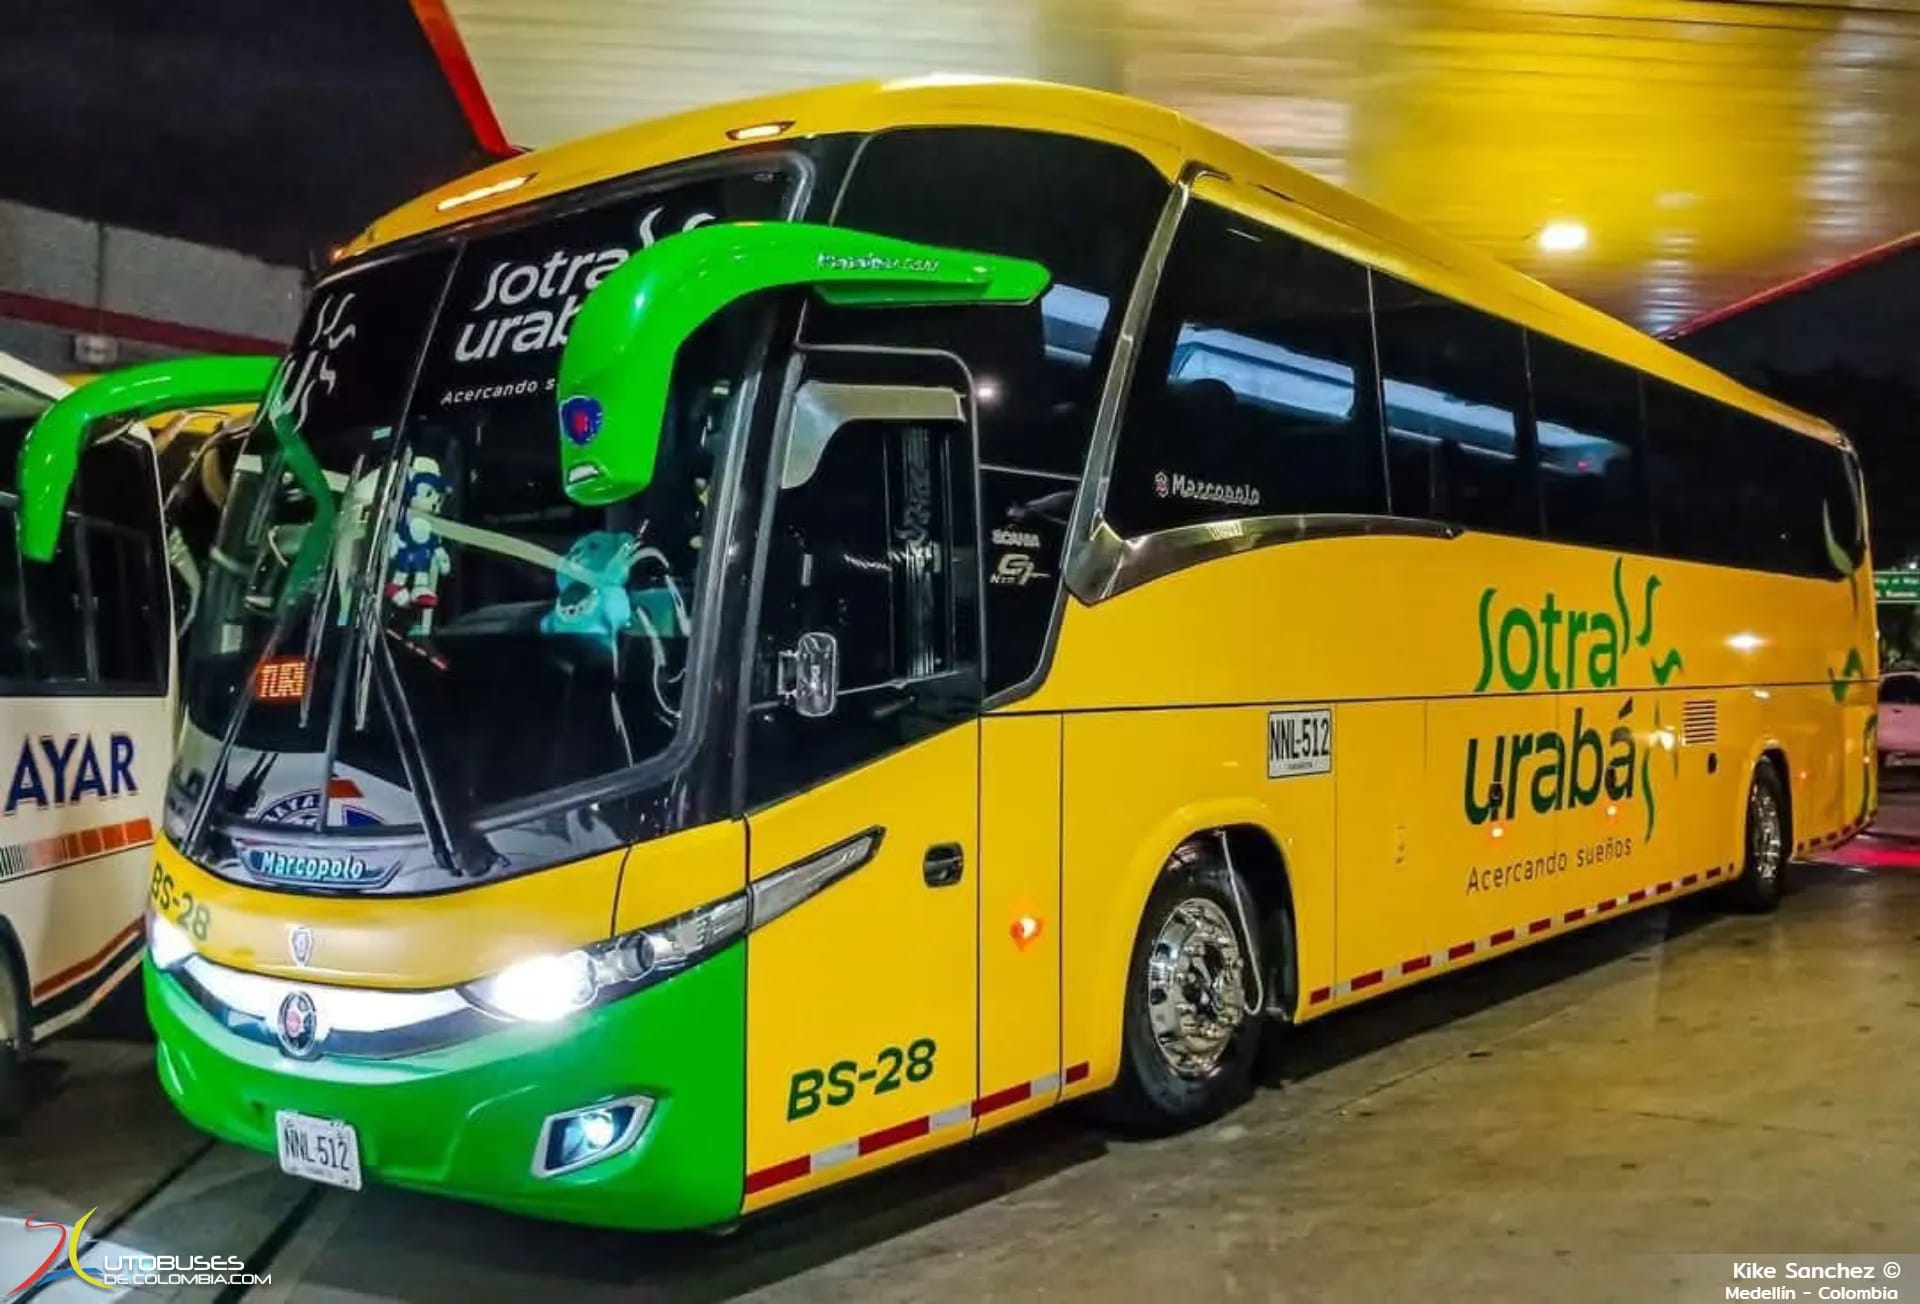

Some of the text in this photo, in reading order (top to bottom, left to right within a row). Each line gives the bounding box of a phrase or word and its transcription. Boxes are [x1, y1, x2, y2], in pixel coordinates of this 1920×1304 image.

[455, 295, 583, 363] urab
[440, 378, 538, 405] Acercando
[1473, 587, 1619, 692] Sotra
[3, 730, 139, 816] AYAR
[1464, 696, 1636, 826] urabá
[151, 861, 211, 942] BS-28
[261, 850, 366, 882] Marcopolo
[1466, 837, 1633, 895] Acercando sueños
[786, 1037, 937, 1122] BS-28
